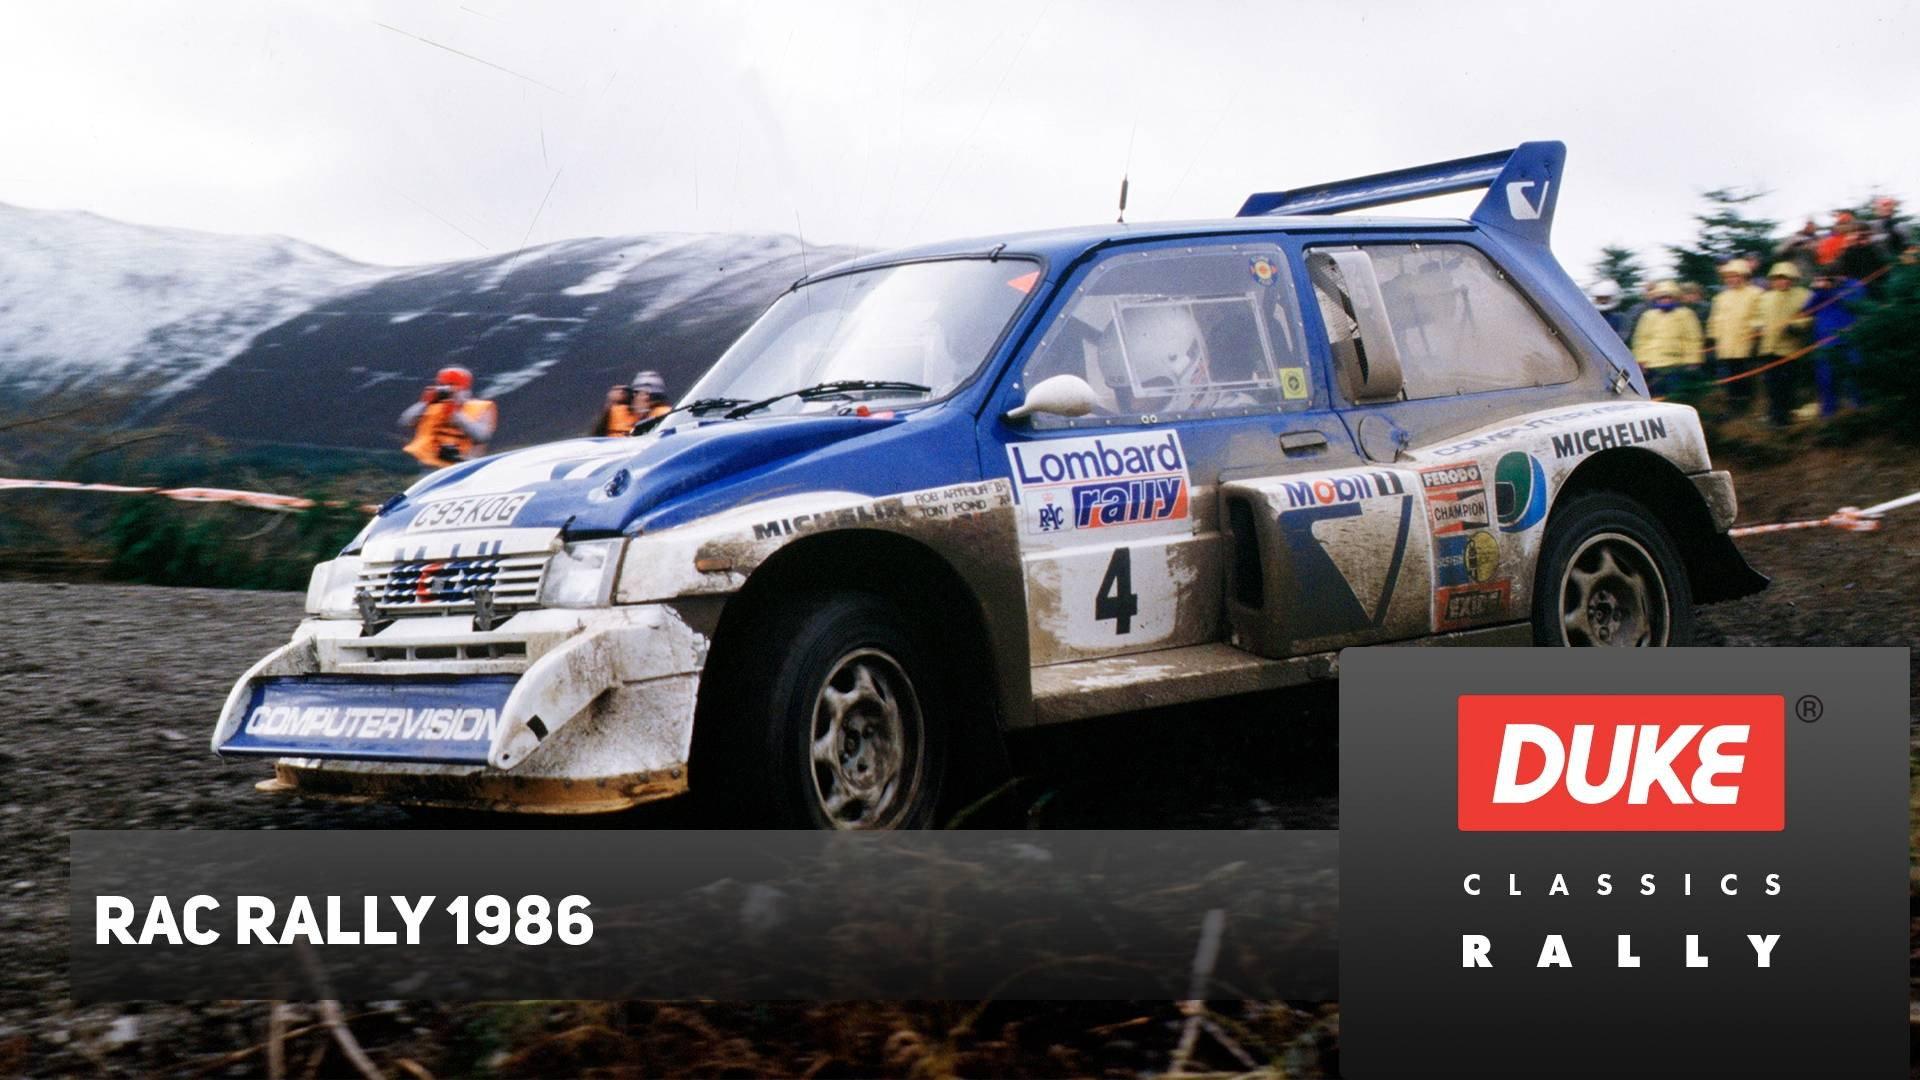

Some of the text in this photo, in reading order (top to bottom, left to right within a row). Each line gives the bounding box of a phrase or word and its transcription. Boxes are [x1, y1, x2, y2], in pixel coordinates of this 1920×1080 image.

[1552, 417, 1667, 458] MICHELIN
[1012, 433, 1182, 484] Lombard
[1423, 468, 1479, 486] FERODO
[1039, 477, 1184, 531] RAC rally
[1281, 474, 1372, 507] Mobil
[1434, 502, 1485, 521] CHAMPION
[1095, 547, 1138, 634] 4
[245, 705, 502, 743] COMPUTERVISION
